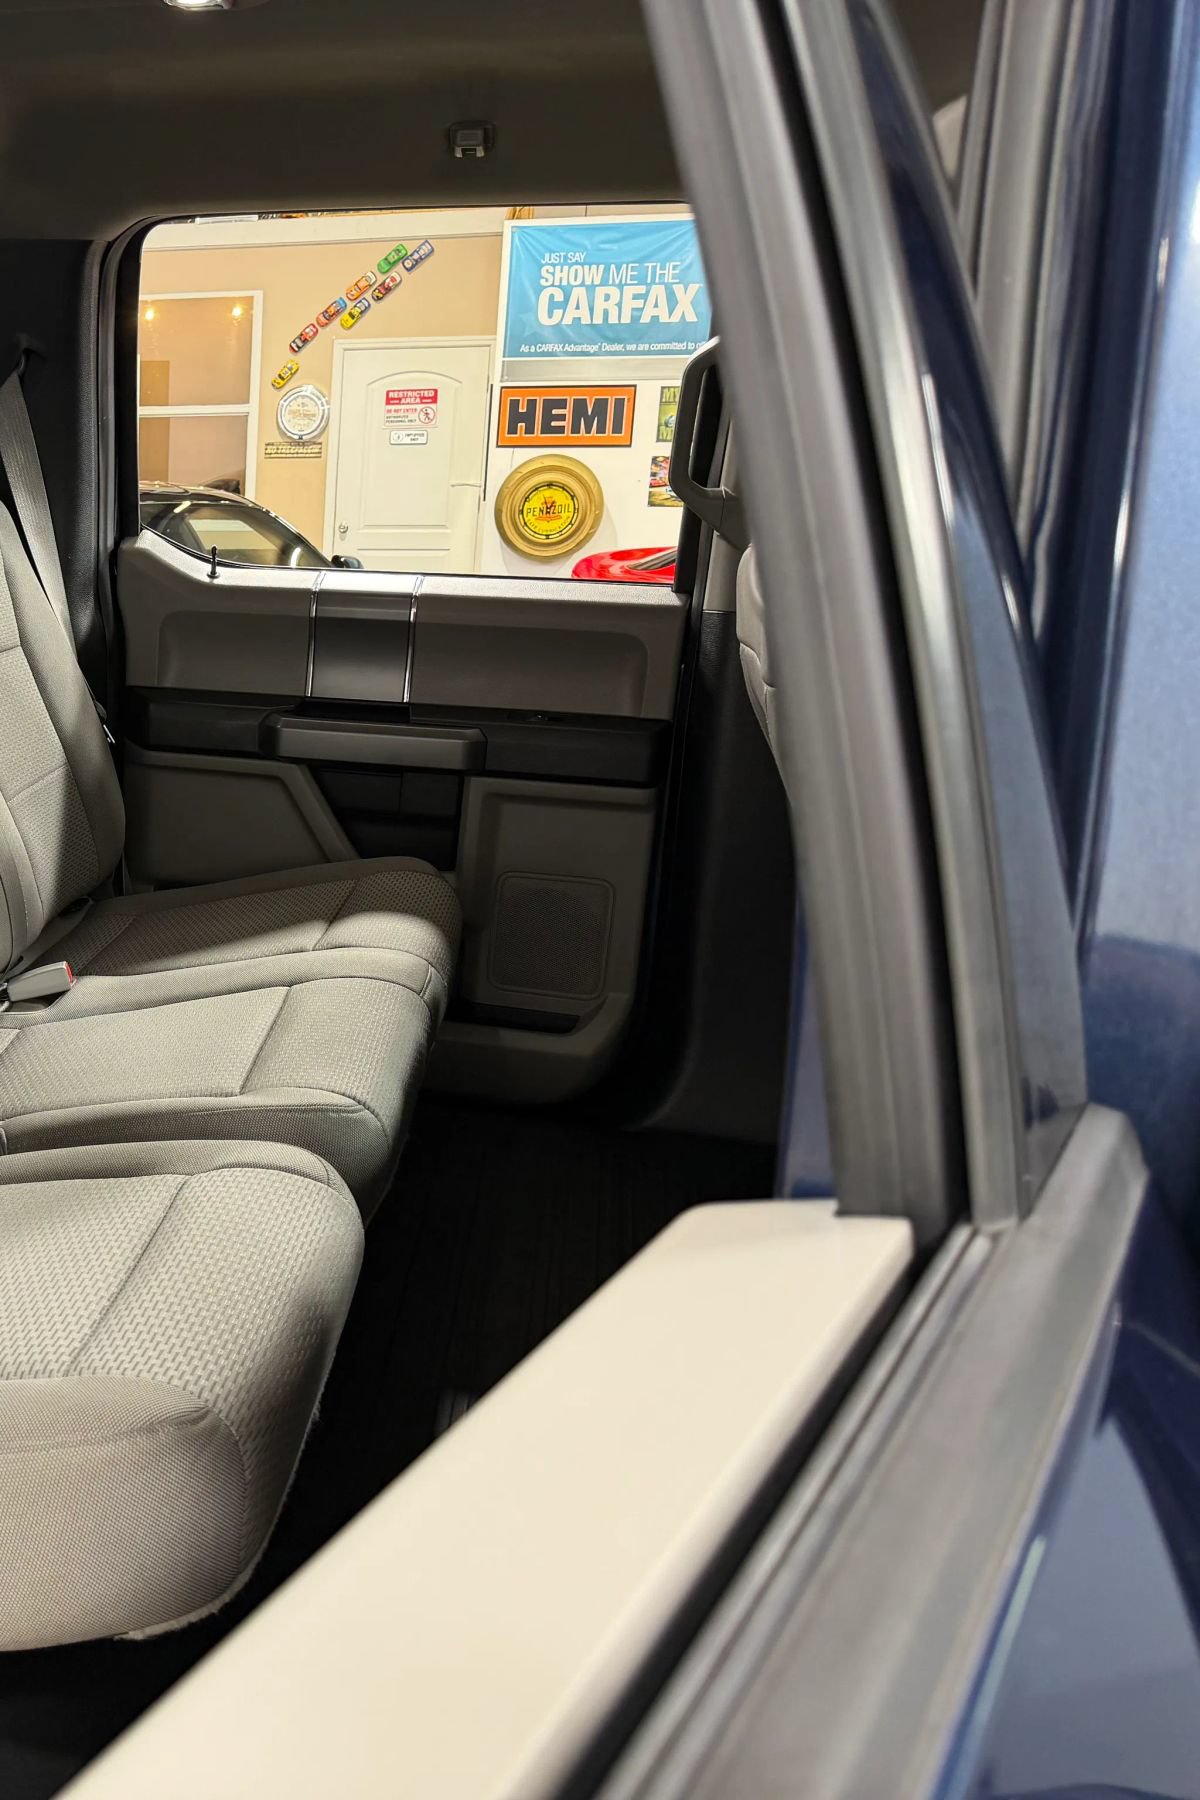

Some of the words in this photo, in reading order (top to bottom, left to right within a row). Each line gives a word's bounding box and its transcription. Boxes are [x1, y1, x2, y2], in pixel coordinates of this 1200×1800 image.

[541, 252, 566, 264] JUST
[567, 251, 586, 263] SAY
[540, 264, 604, 286] SHOW
[609, 263, 639, 284] ME
[644, 262, 681, 283] THE
[538, 285, 700, 325] CARFAX
[536, 343, 563, 352] CARFAX
[650, 341, 687, 350] committed
[506, 397, 629, 436] HEMI
